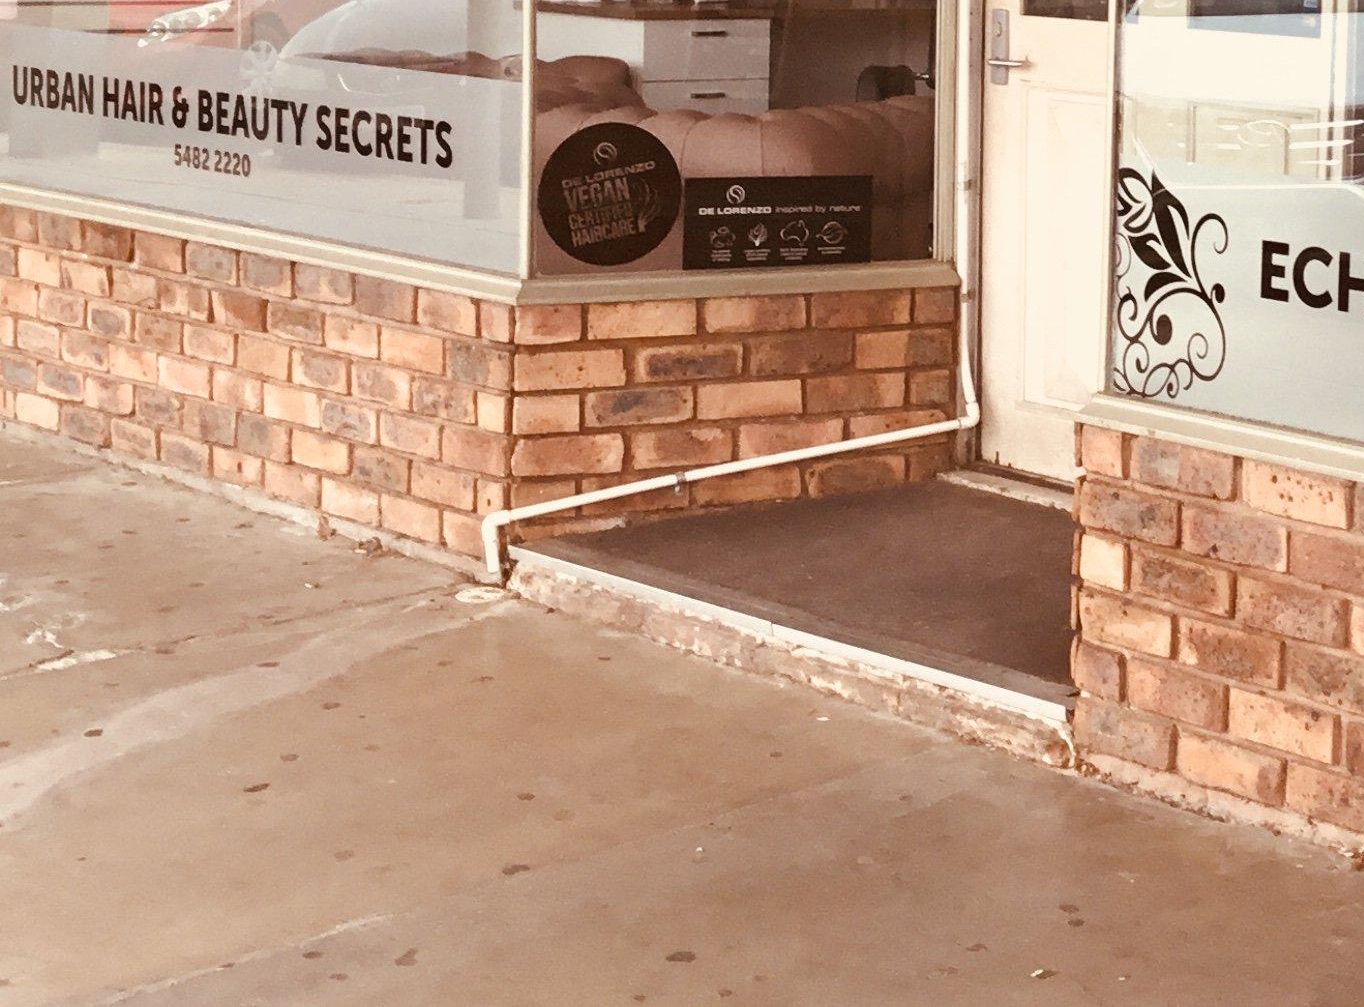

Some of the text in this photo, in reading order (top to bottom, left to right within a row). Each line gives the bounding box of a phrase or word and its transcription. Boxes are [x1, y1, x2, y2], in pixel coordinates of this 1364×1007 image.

[13, 64, 454, 169] URBAN HAIR & BEAUTY SECRETS
[174, 144, 251, 178] 5482 2220
[563, 176, 631, 211] VEGAN
[699, 207, 715, 216] DE
[717, 205, 772, 216] LORENZO
[815, 205, 826, 214] by
